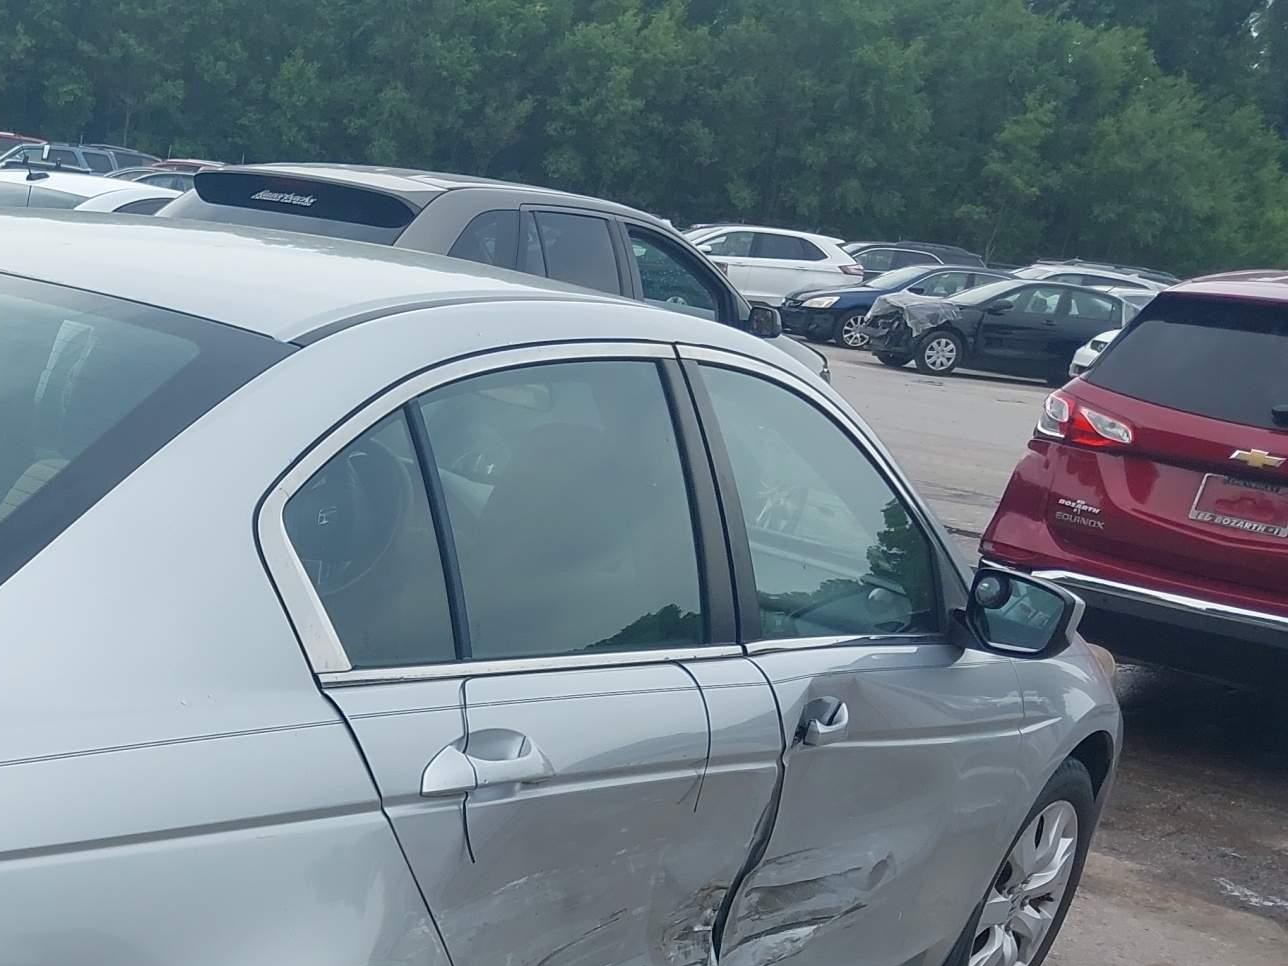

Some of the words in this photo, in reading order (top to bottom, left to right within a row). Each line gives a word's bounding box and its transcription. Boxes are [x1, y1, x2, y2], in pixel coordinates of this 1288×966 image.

[1058, 498, 1101, 514] BOZARTH
[1056, 511, 1105, 530] EQUINOX
[1215, 516, 1266, 533] BOZARTH
